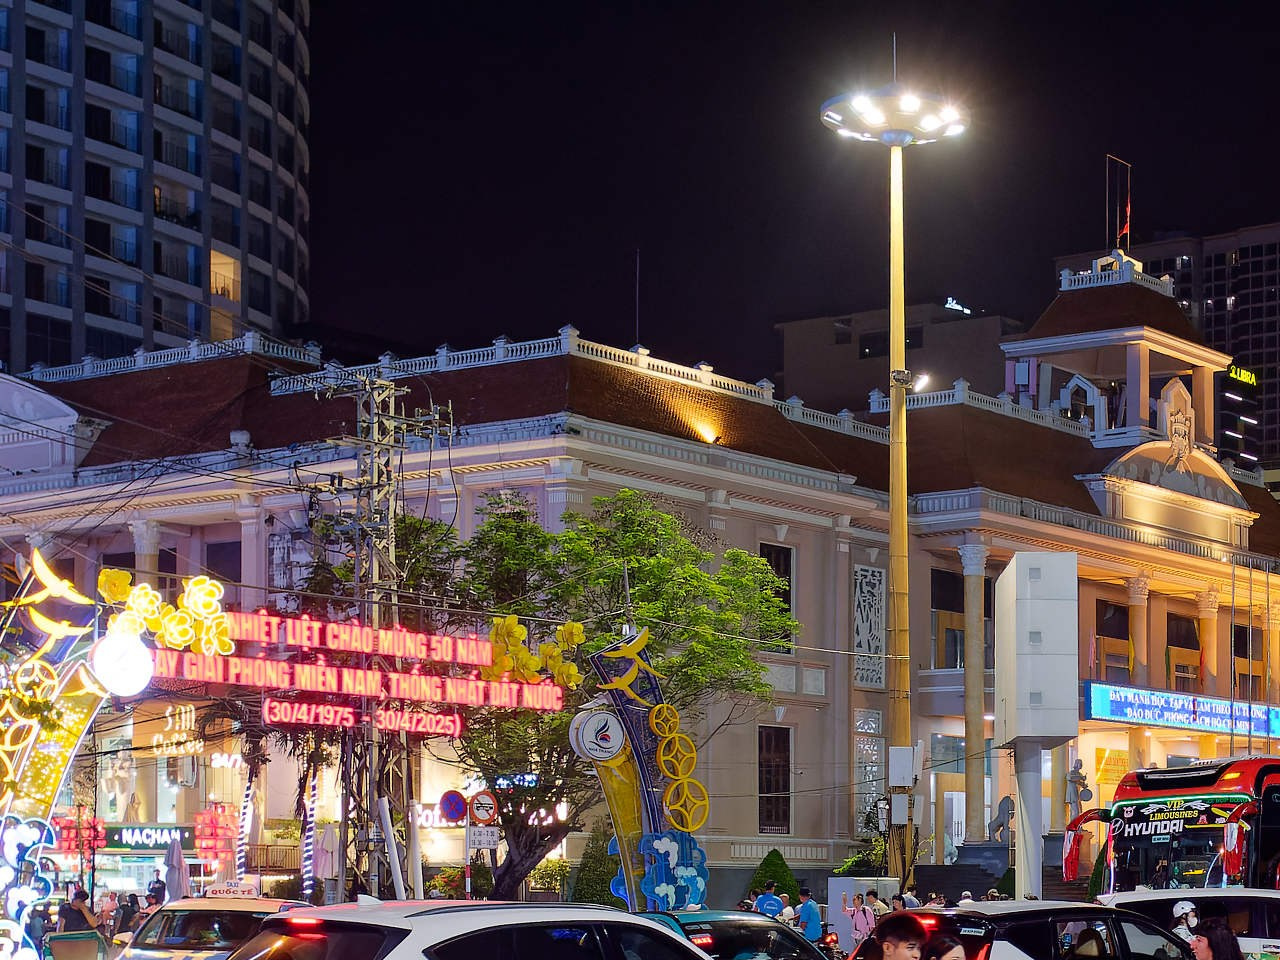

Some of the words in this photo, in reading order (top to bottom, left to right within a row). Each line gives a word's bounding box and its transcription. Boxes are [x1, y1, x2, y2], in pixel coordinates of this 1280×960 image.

[1236, 367, 1257, 386] LIBRA
[228, 608, 279, 648] NHIỆT
[285, 613, 322, 652] LIỆT
[326, 618, 373, 653] CHÀO
[378, 623, 428, 660] MỪNG
[430, 635, 452, 663] 50
[457, 633, 493, 667] NĂM
[228, 652, 290, 690] PHÓNG
[295, 653, 338, 693] MIỀN
[388, 664, 443, 702] THỐNG
[446, 670, 486, 706] NHẤT
[522, 678, 564, 711] NƯỚC
[263, 698, 355, 727] (30/4/1975
[375, 709, 462, 738] 30/4/2025)
[1212, 703, 1230, 715] THEO
[1164, 713, 1189, 724] PHONG
[152, 732, 205, 756] Coffee
[1166, 800, 1185, 809] VIP
[1150, 810, 1199, 820] LIMOUSINES
[1124, 819, 1184, 837] HYUNDAI
[211, 887, 239, 895] QUỐC
[241, 887, 254, 895] TẾ
